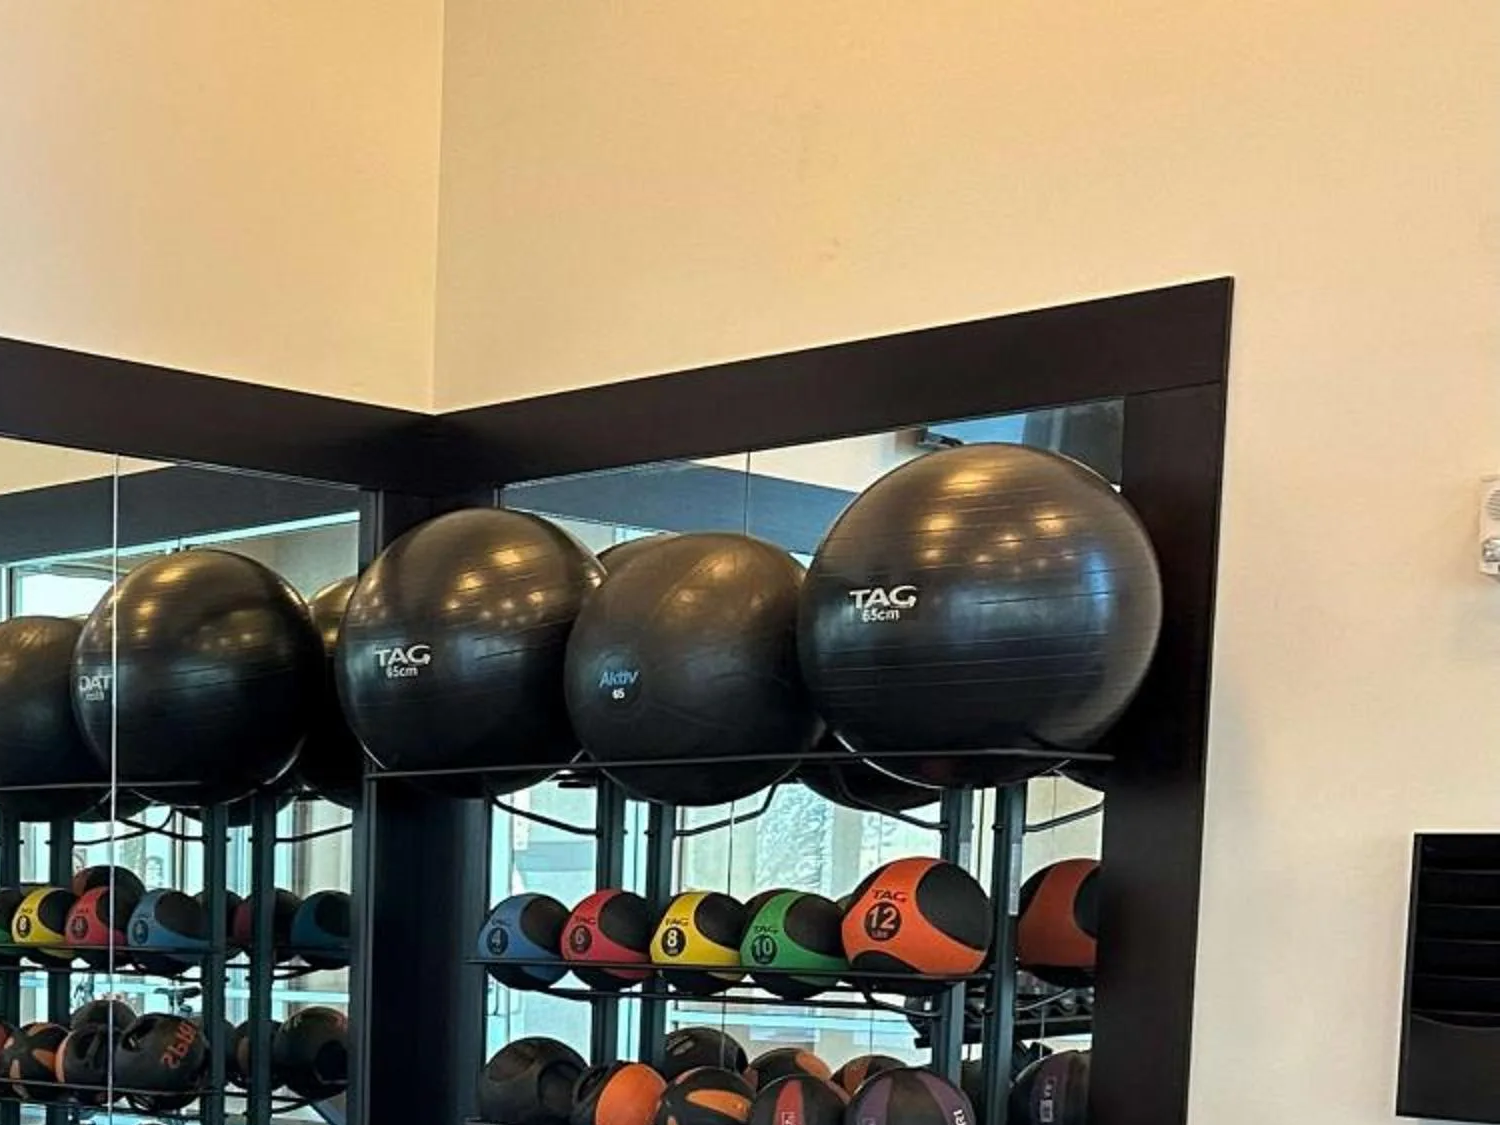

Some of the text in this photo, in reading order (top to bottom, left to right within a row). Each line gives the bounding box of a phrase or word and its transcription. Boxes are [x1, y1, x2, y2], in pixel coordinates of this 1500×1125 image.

[849, 585, 917, 609] TAG
[862, 608, 900, 622] 65cm
[375, 645, 431, 667] TAG
[869, 906, 897, 929] 12
[667, 929, 678, 947] 8
[754, 938, 773, 955] 10
